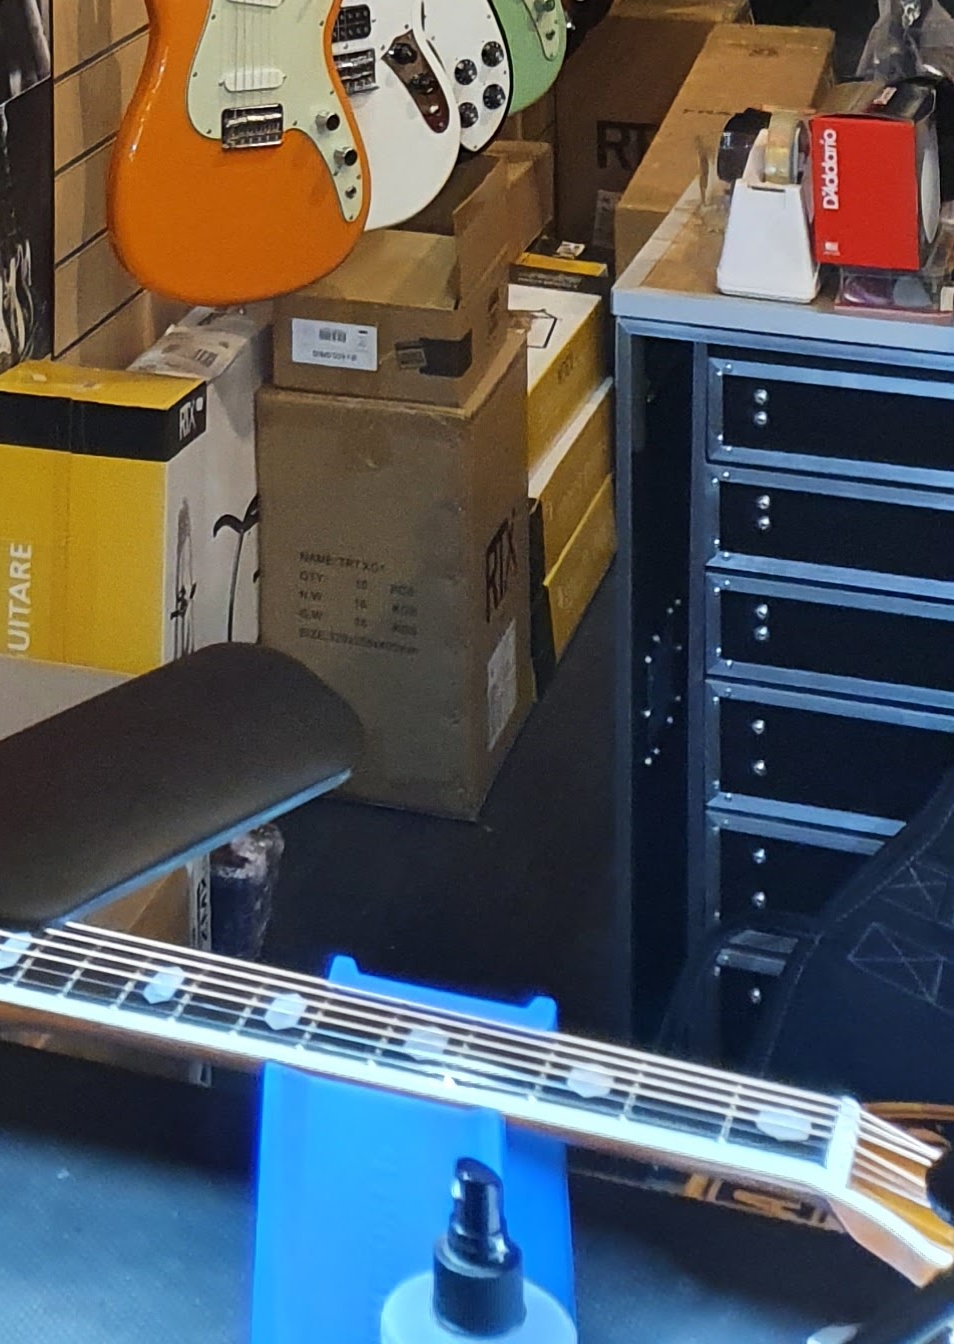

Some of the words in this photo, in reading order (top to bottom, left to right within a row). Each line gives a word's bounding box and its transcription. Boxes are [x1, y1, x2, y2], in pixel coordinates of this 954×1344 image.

[821, 128, 837, 211] D'Addario
[178, 399, 197, 441] RTX
[6, 542, 32, 653] UITARE
[486, 508, 518, 623] RTX
